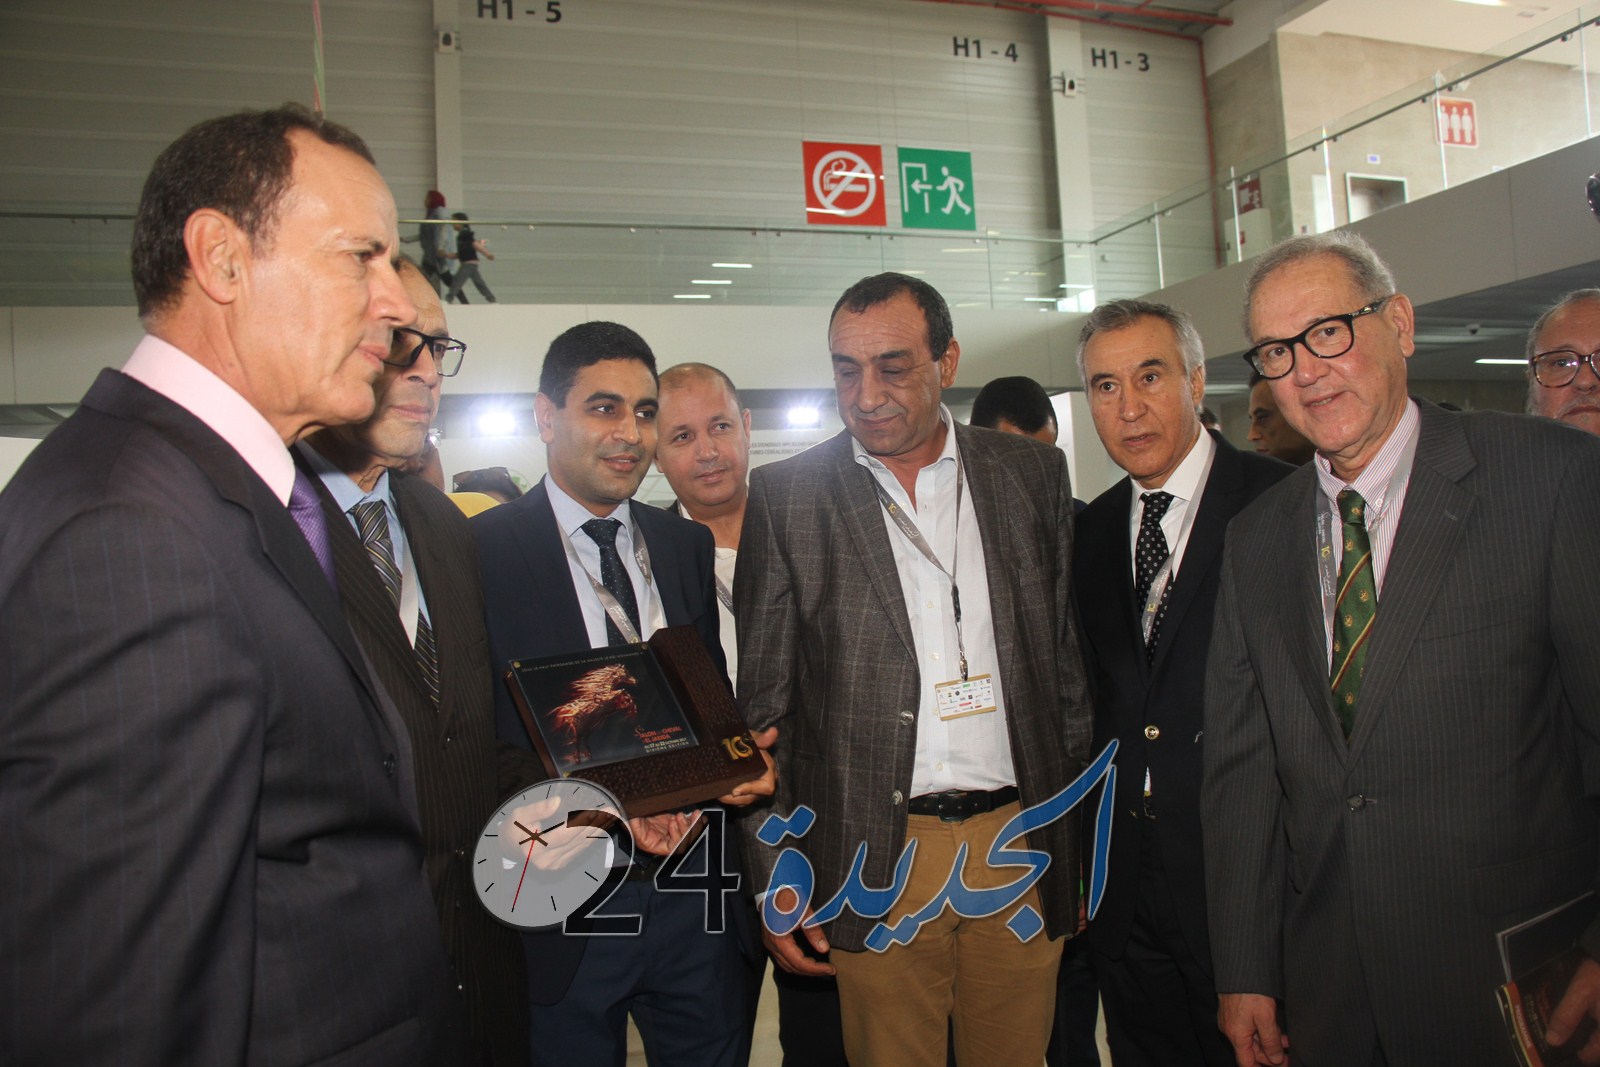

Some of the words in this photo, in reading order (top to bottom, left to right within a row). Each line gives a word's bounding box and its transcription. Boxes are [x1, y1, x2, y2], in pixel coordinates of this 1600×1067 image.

[478, 0, 513, 20] H1
[546, 1, 562, 22] 5
[953, 36, 982, 59] H1
[1005, 43, 1018, 62] 4
[1091, 48, 1118, 69] H1
[1137, 53, 1150, 72] 3
